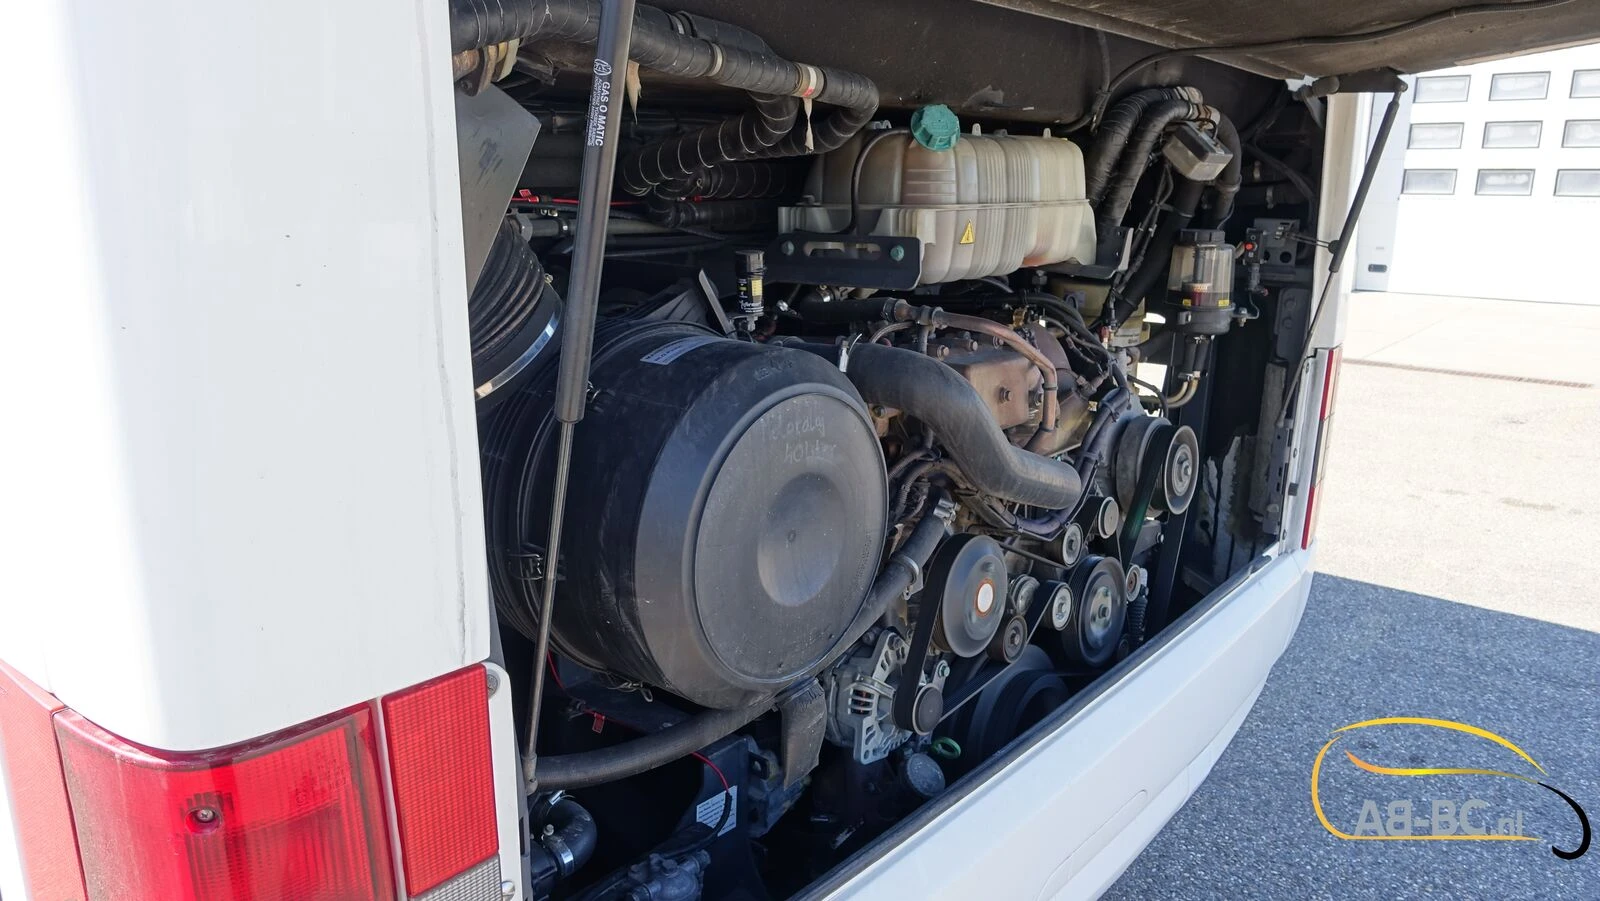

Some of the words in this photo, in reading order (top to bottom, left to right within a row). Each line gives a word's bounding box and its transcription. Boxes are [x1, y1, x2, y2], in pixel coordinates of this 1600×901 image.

[600, 81, 611, 103] GAS
[599, 104, 608, 113] O
[594, 115, 607, 147] MATIC
